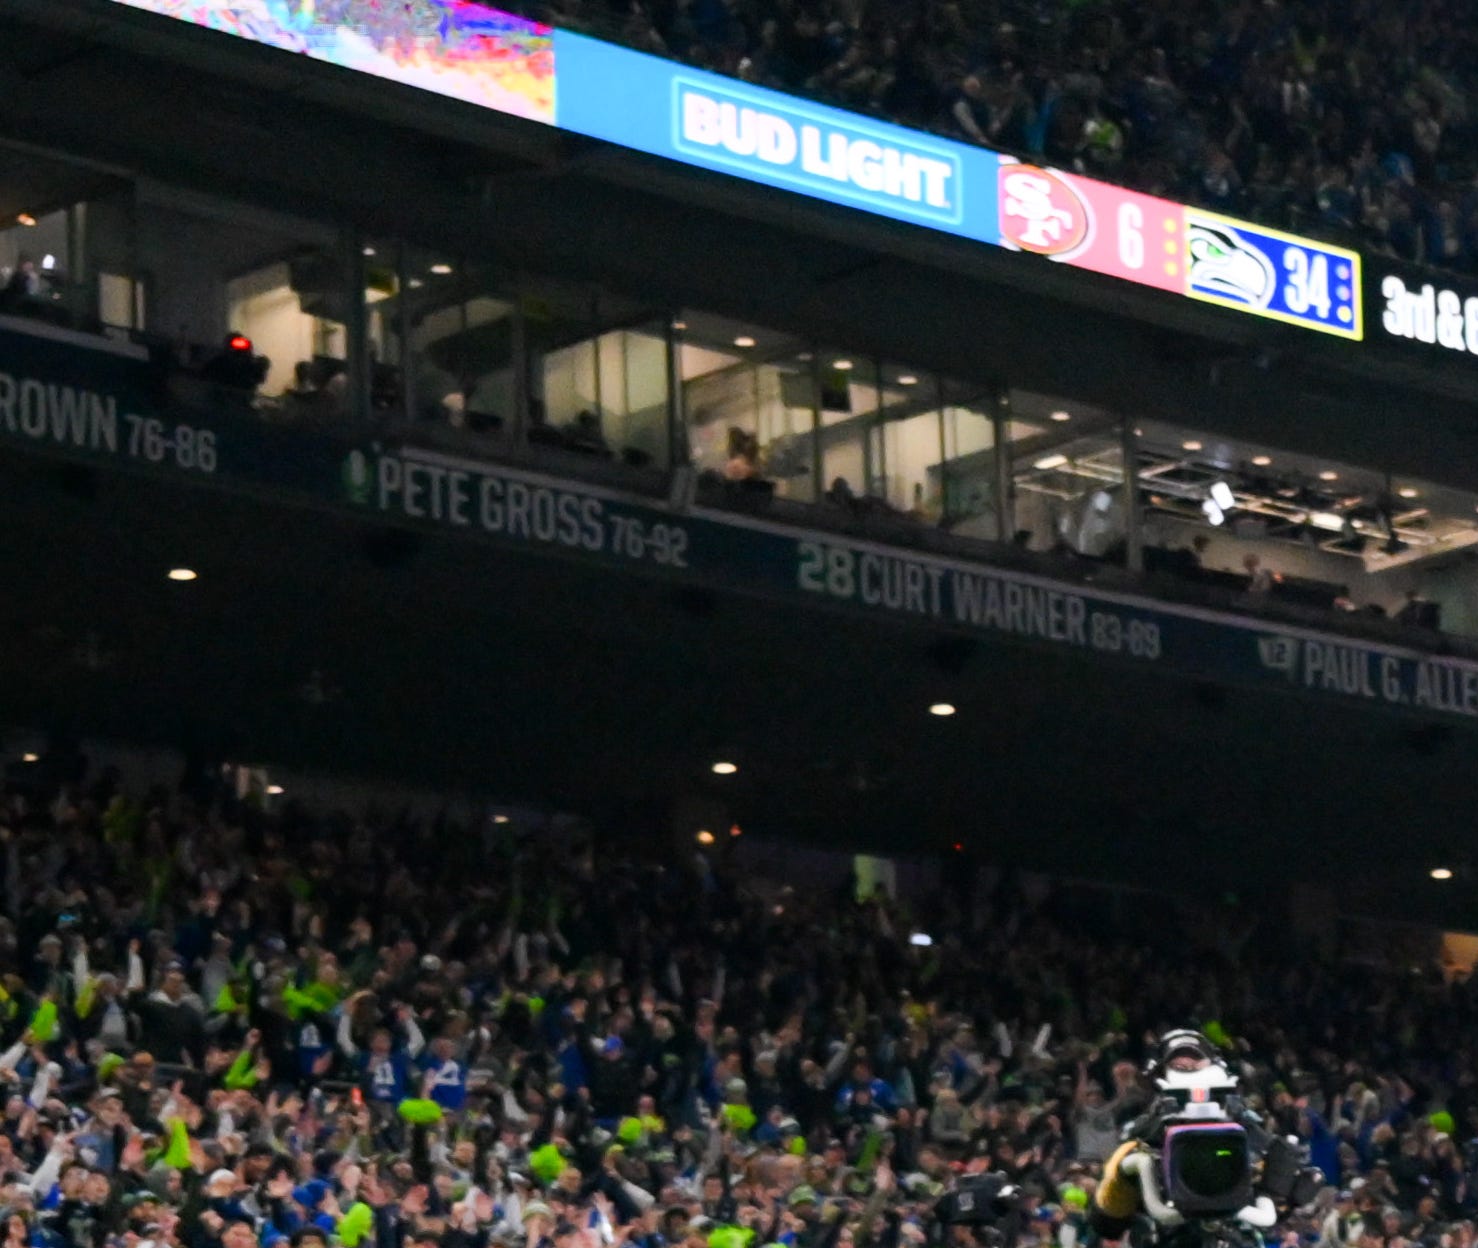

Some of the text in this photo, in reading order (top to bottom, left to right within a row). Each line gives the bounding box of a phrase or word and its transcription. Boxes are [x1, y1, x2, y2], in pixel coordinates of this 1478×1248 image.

[684, 92, 951, 208] BUD LIGHT
[1117, 202, 1144, 269] 6
[1283, 246, 1331, 319] 34
[124, 414, 216, 473] 76-86
[378, 456, 688, 568] PETE GROSS 76-92
[797, 543, 855, 596] 28
[860, 555, 943, 616] CURT
[952, 569, 1086, 647] WARNER
[1304, 640, 1376, 697] PAUL
